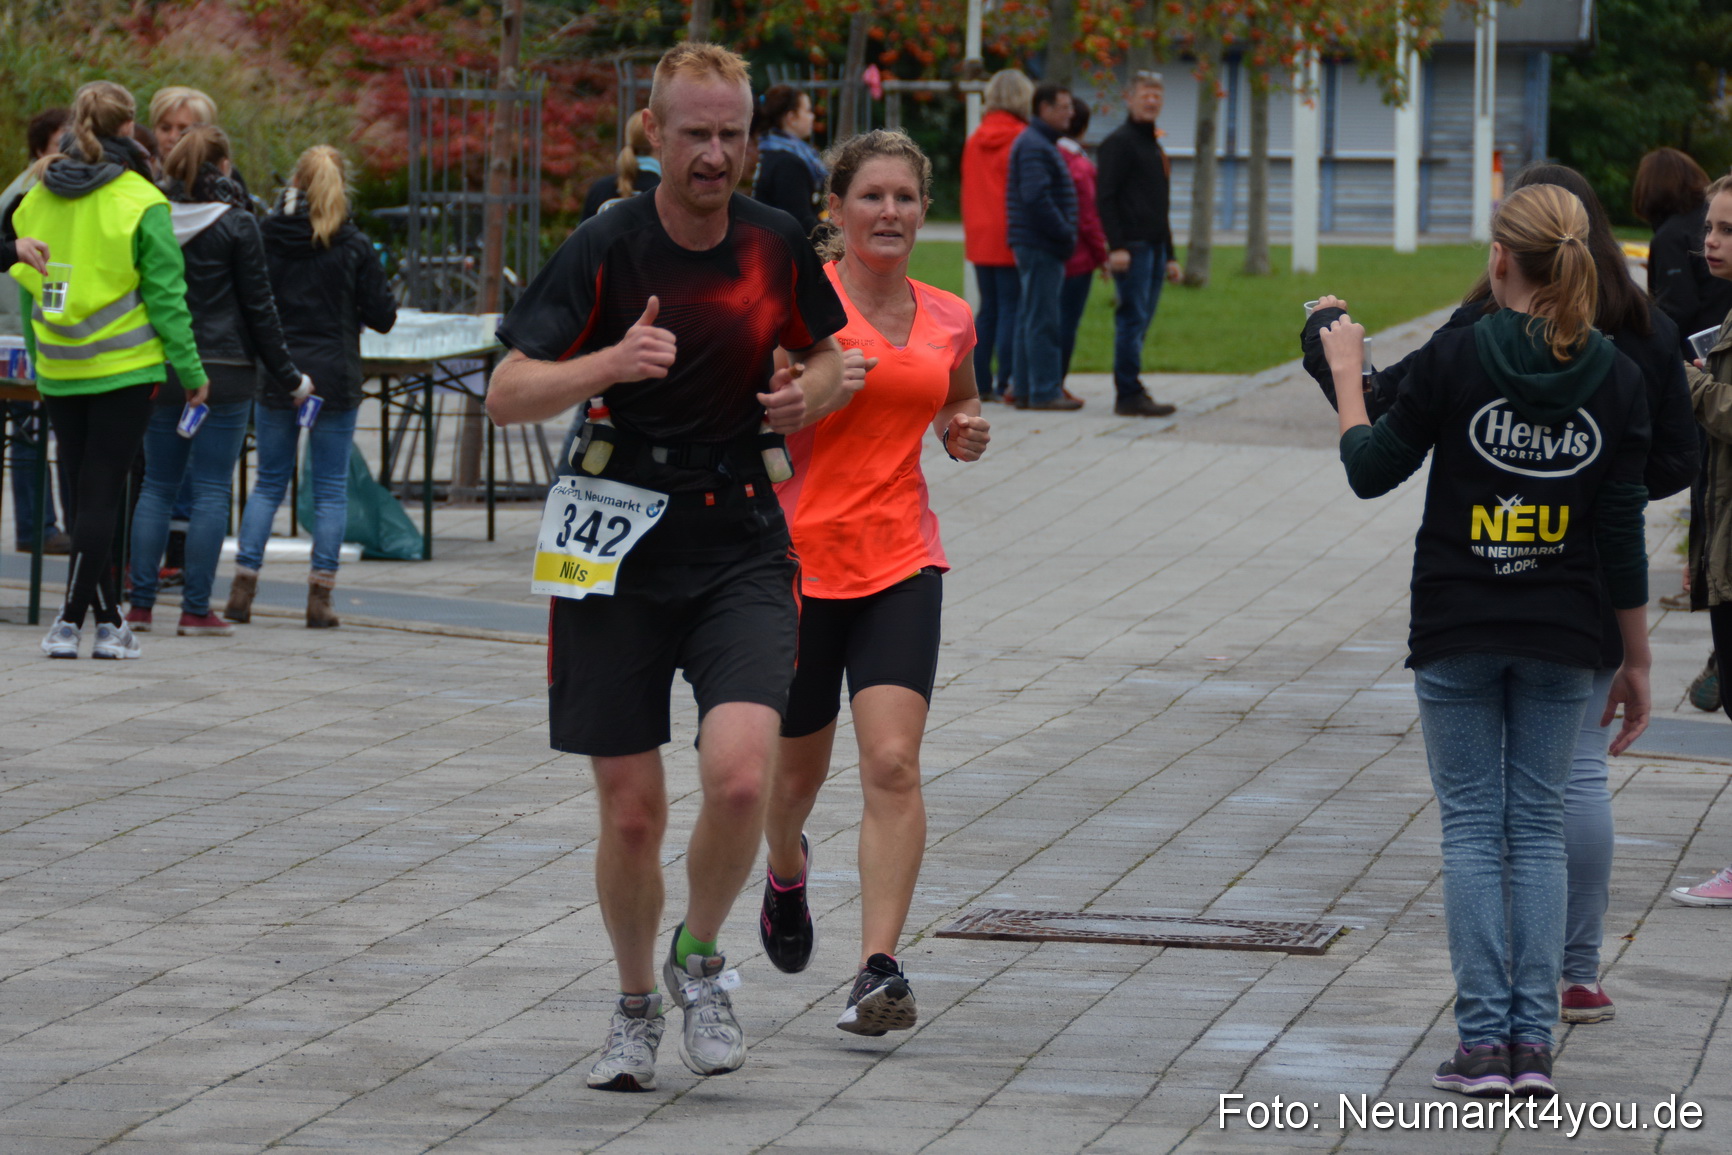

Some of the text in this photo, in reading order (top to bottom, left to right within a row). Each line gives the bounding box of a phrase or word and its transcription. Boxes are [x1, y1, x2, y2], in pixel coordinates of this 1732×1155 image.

[837, 338, 859, 346] FINISH
[1485, 409, 1589, 460] Hervis
[1491, 447, 1543, 461] SPORTS
[584, 490, 641, 513] Neumarkt
[556, 503, 632, 557] 342
[1471, 504, 1569, 543] NEU
[1471, 543, 1565, 559] IN NEUMARKT
[559, 561, 589, 583] Nils
